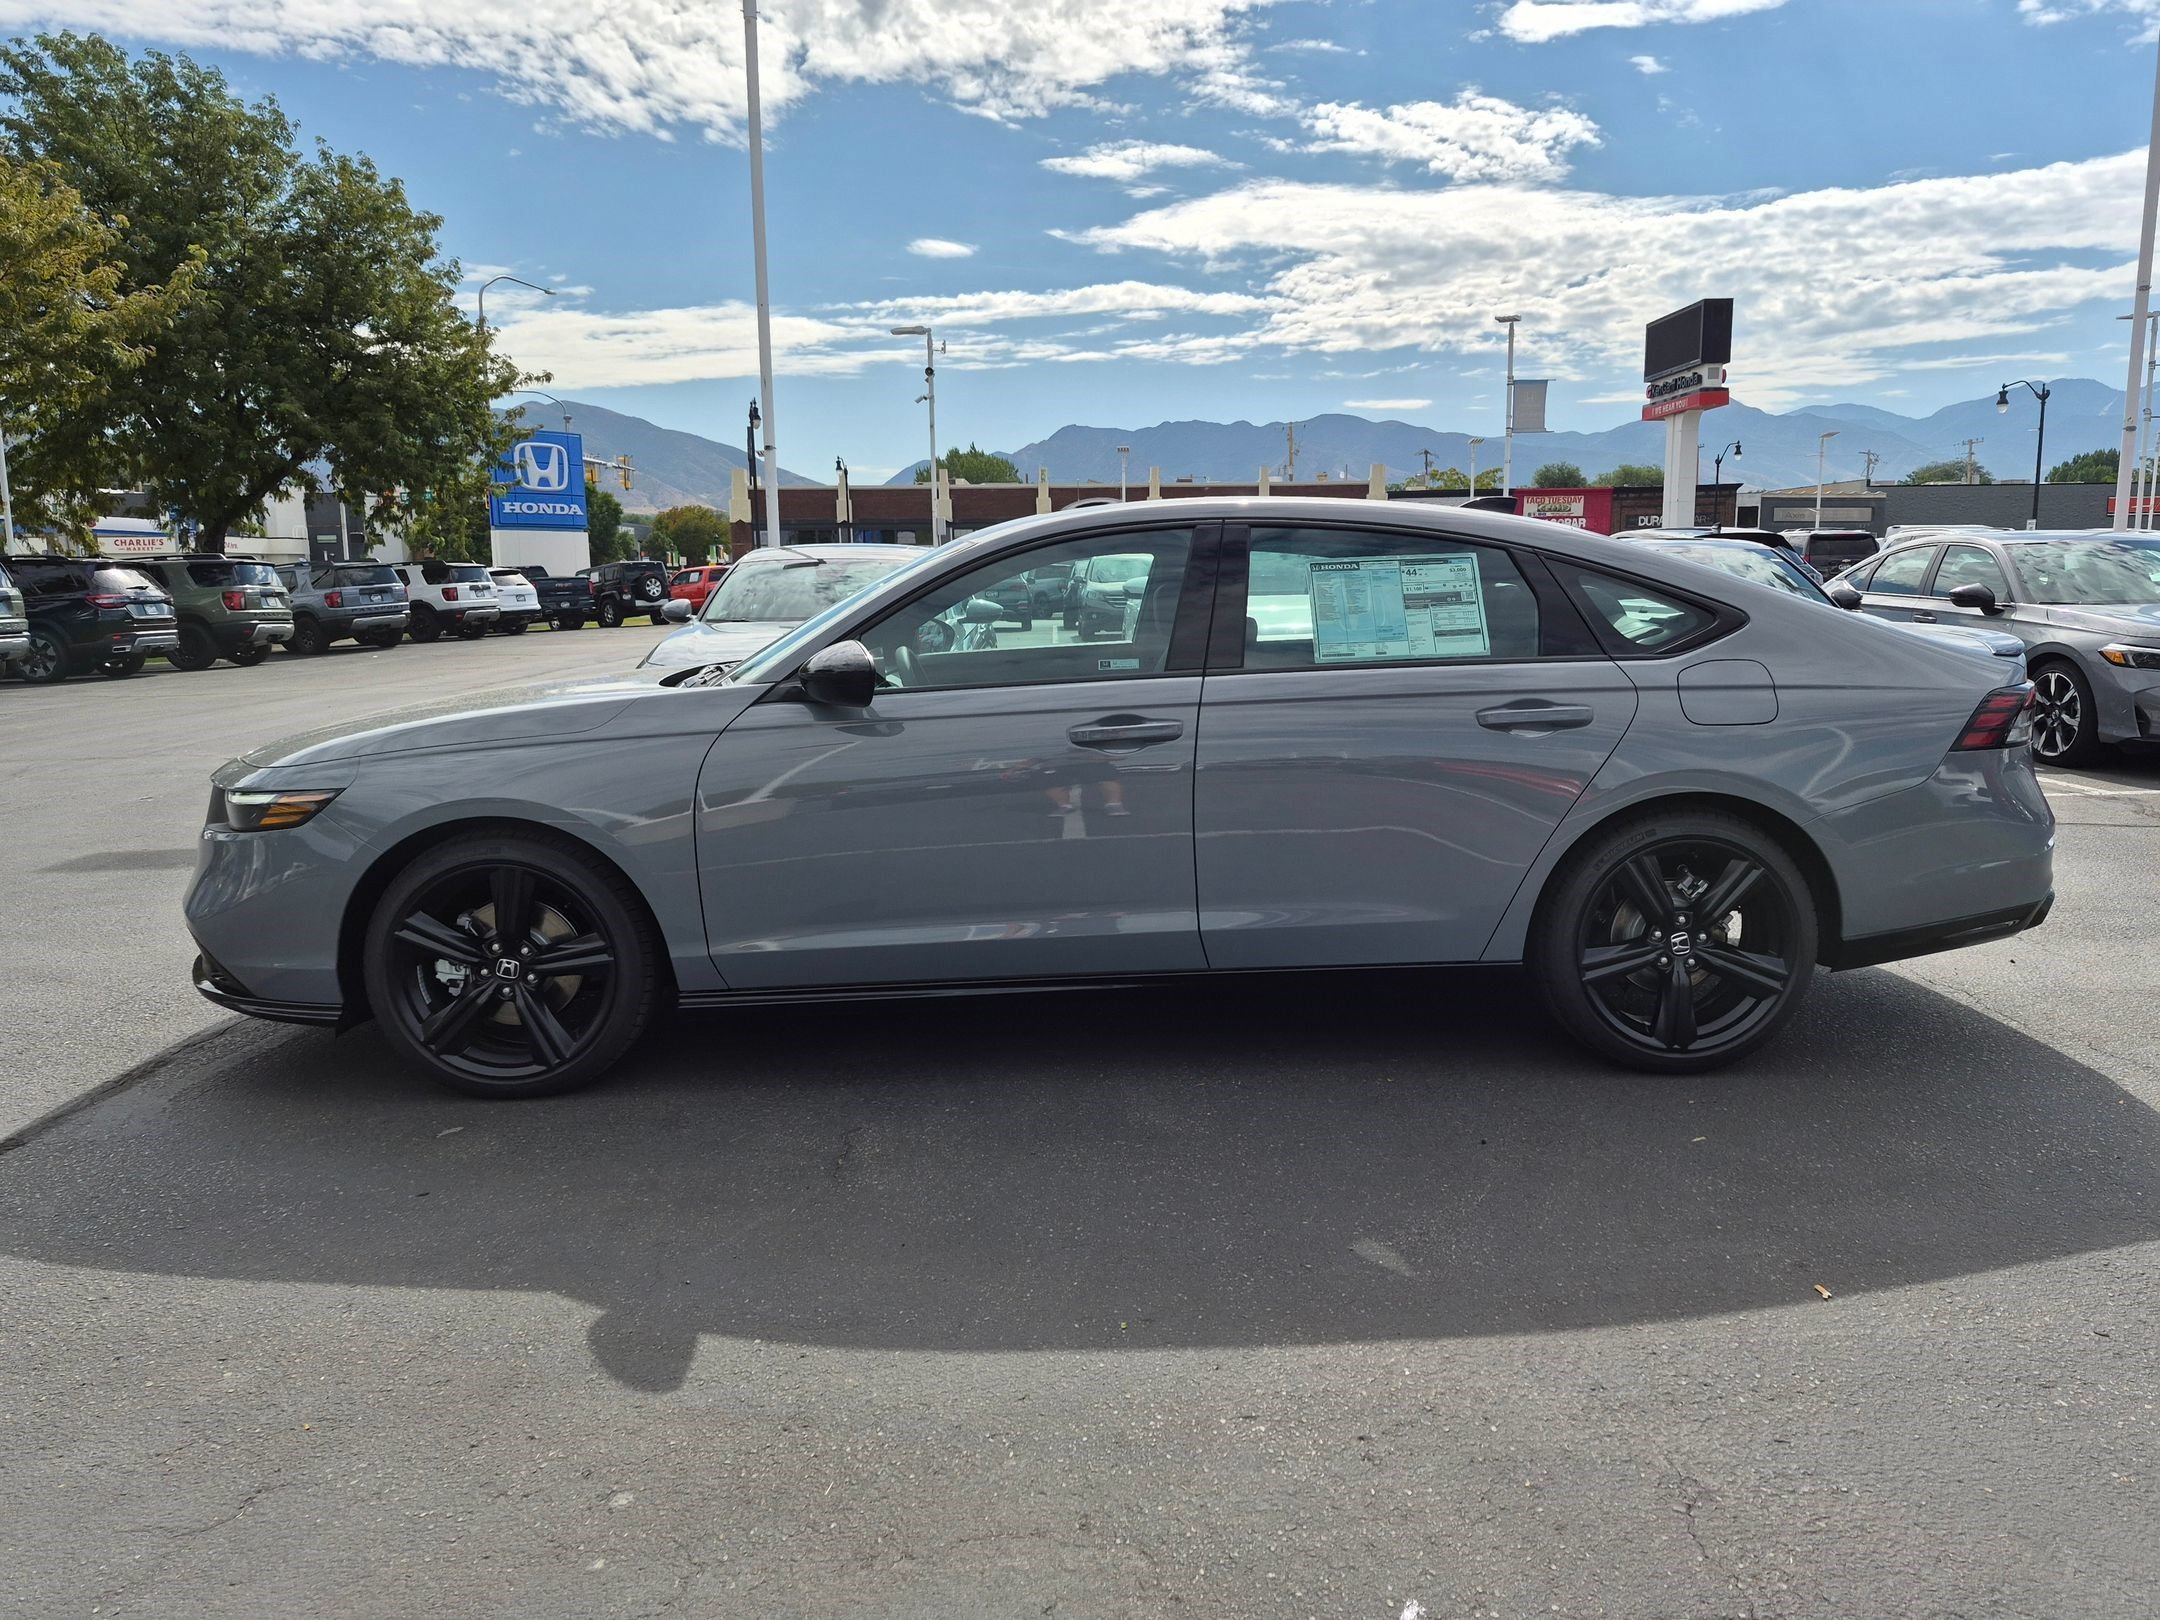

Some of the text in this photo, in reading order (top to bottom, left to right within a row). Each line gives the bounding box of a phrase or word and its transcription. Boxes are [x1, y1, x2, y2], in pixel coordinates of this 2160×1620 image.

[1676, 373, 1700, 389] Honda
[1662, 402, 1675, 413] HEAR
[1526, 496, 1582, 504] TACO TUESDAY
[502, 502, 584, 515] HONDA
[114, 538, 164, 546] CHARLIE'S
[1405, 568, 1417, 577] 44
